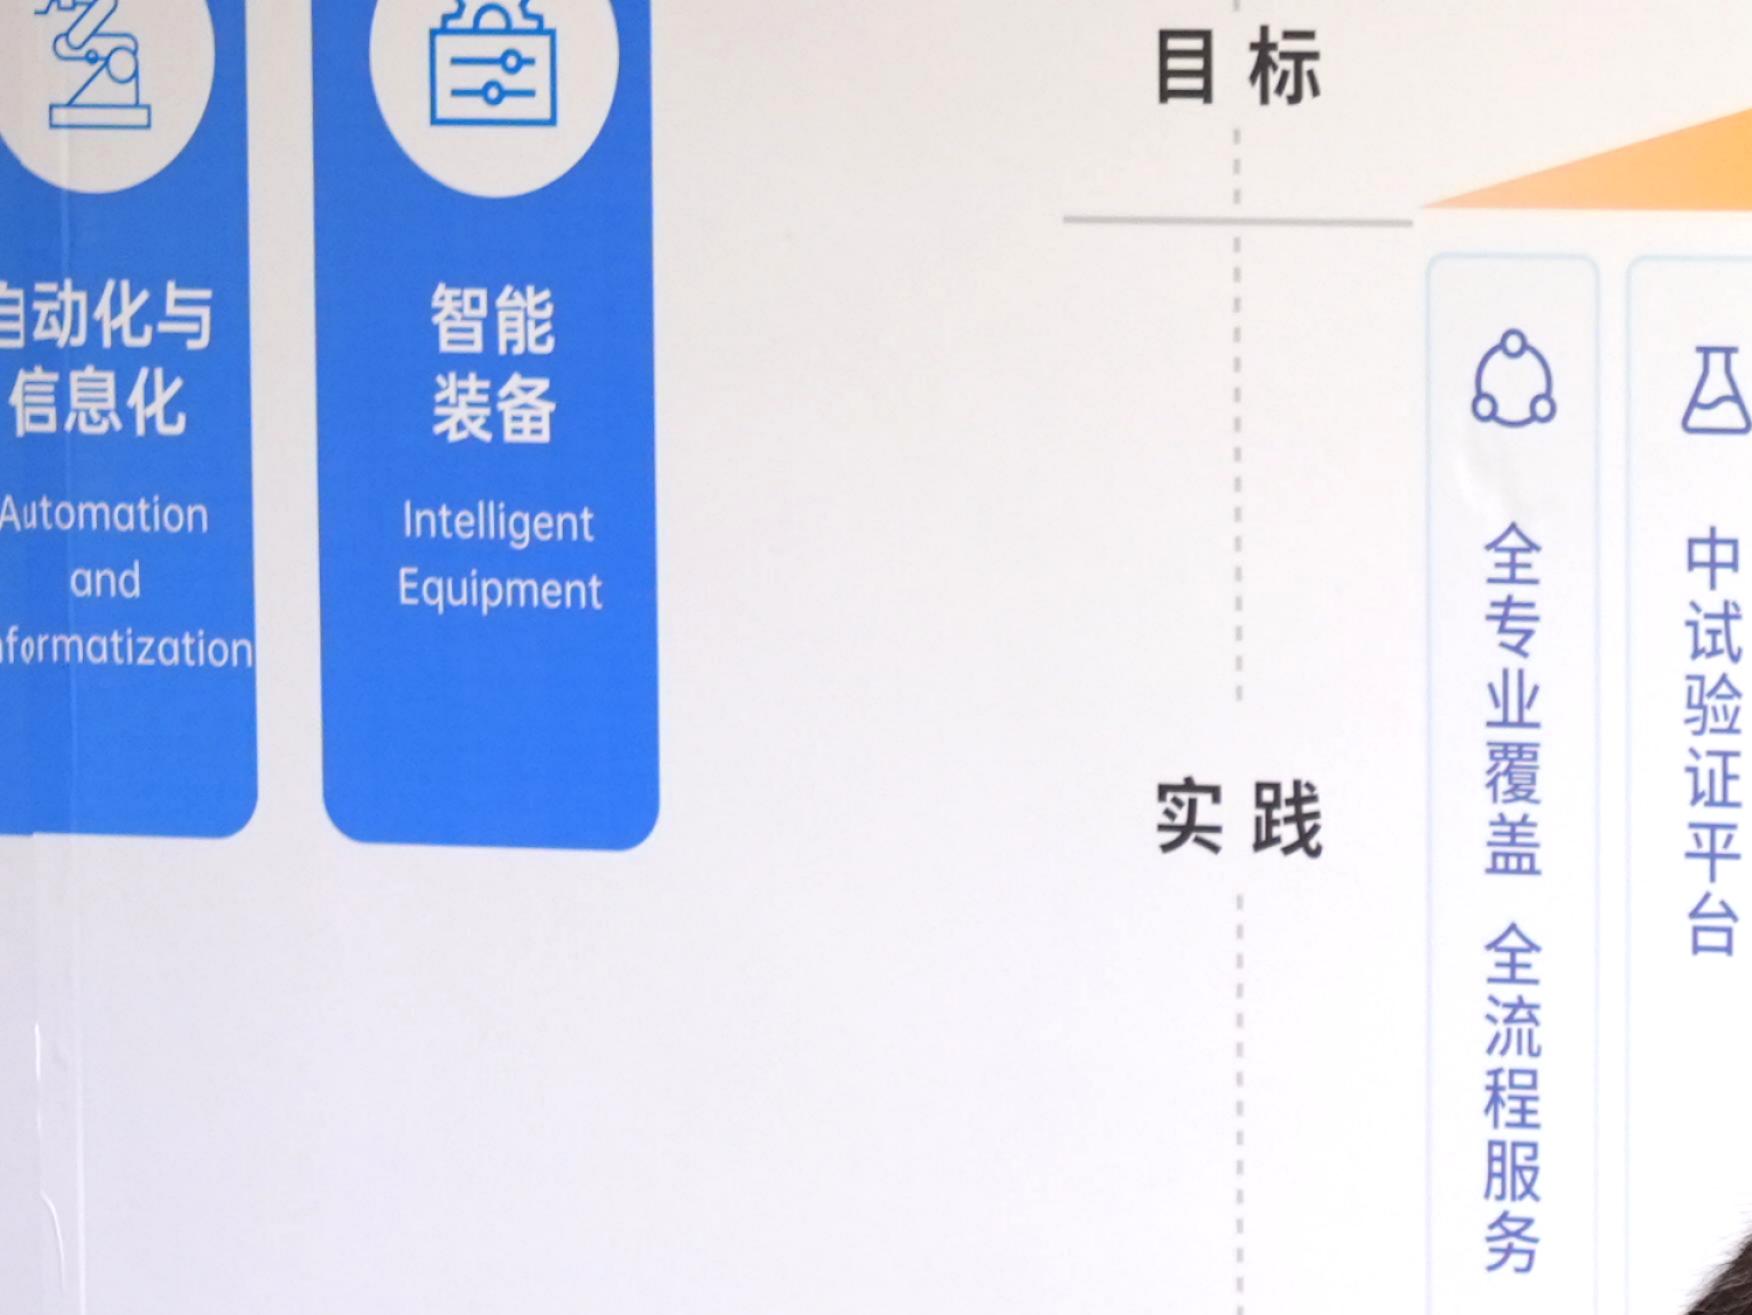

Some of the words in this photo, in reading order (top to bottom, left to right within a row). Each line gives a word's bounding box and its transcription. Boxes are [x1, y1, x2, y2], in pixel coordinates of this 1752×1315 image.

[1159, 25, 1322, 107] 目标
[0, 278, 214, 352] 自动化与
[432, 283, 556, 357] 智能
[9, 365, 188, 439] 信息化
[433, 372, 557, 445] 装备
[0, 495, 209, 534] Automation
[405, 500, 596, 552] Intelligent
[71, 560, 142, 600] and
[400, 567, 604, 617] Equipment
[0, 626, 257, 669] formatization
[1484, 521, 1543, 877] 全专业覆盖
[1684, 526, 1744, 958] 中试验证平台
[1157, 776, 1324, 860] 实践
[1484, 922, 1543, 1275] 全流程服务
